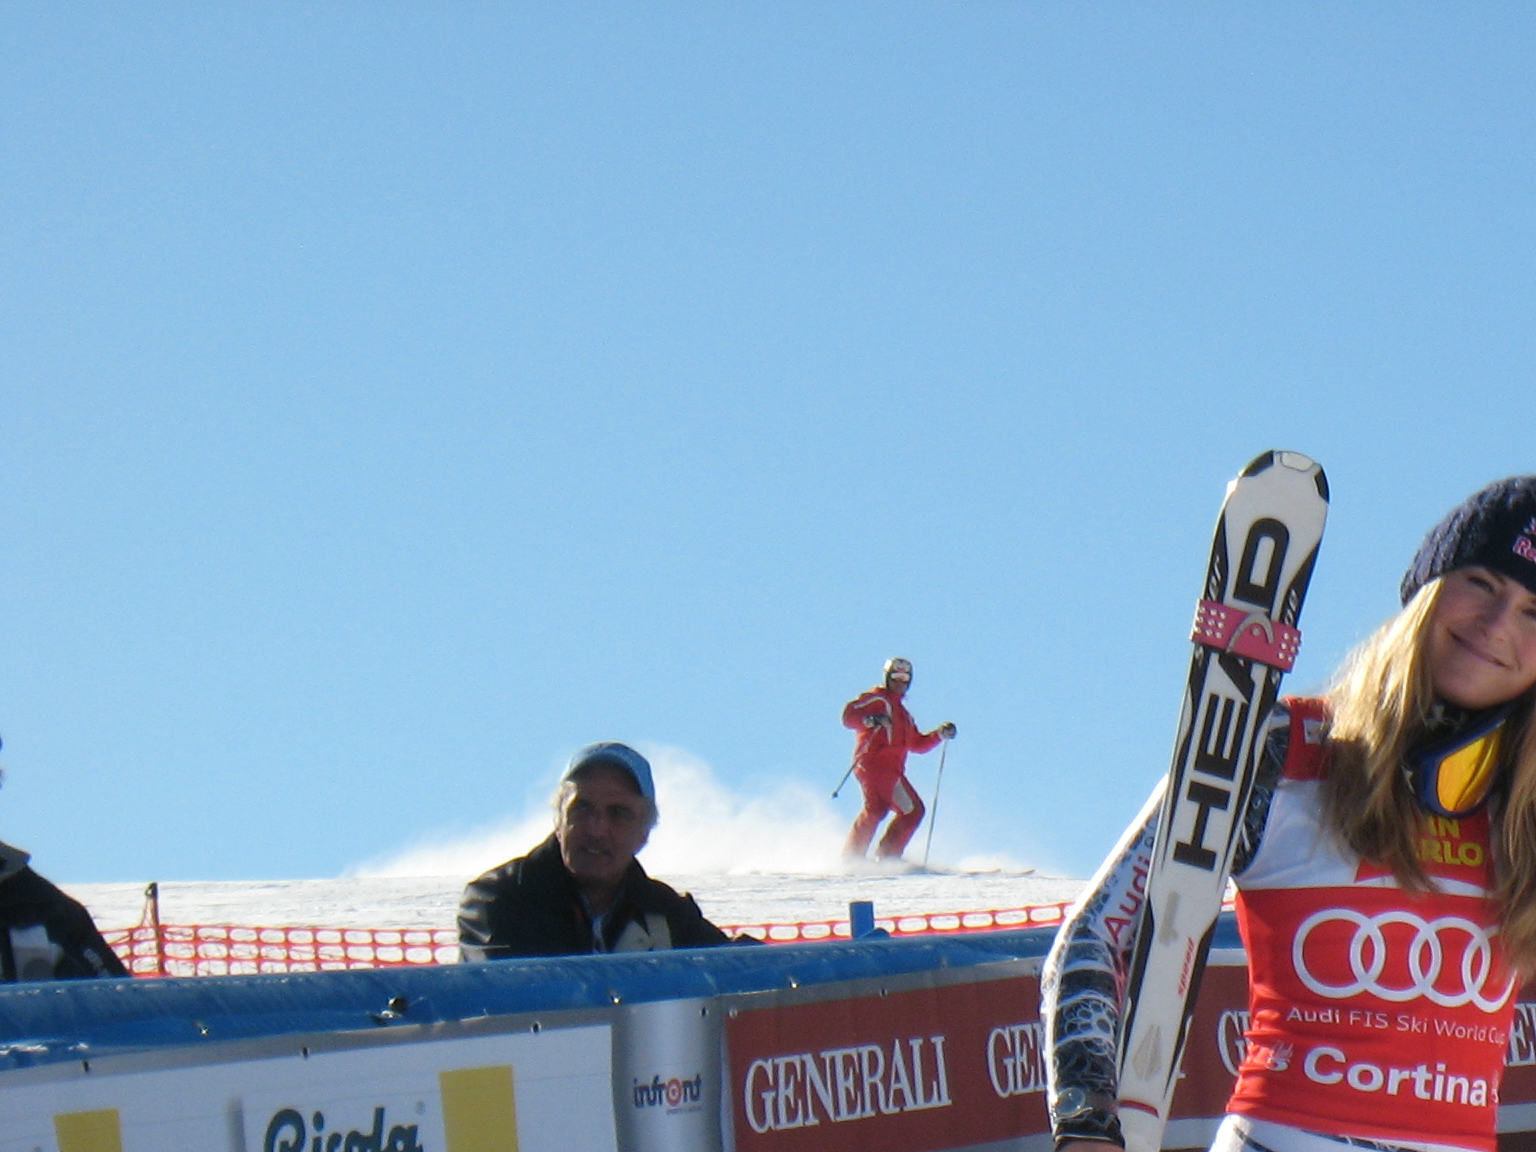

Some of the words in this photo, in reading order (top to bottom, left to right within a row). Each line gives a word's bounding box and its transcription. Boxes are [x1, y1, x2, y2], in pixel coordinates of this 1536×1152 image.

[1417, 837, 1484, 867] RLO
[1286, 1007, 1341, 1025] Audi
[1350, 1010, 1389, 1030] FIS
[1396, 1014, 1428, 1034] Ski
[1433, 1018, 1486, 1042] World
[743, 1036, 953, 1134] GENERALI
[1303, 1045, 1488, 1107] Cortina
